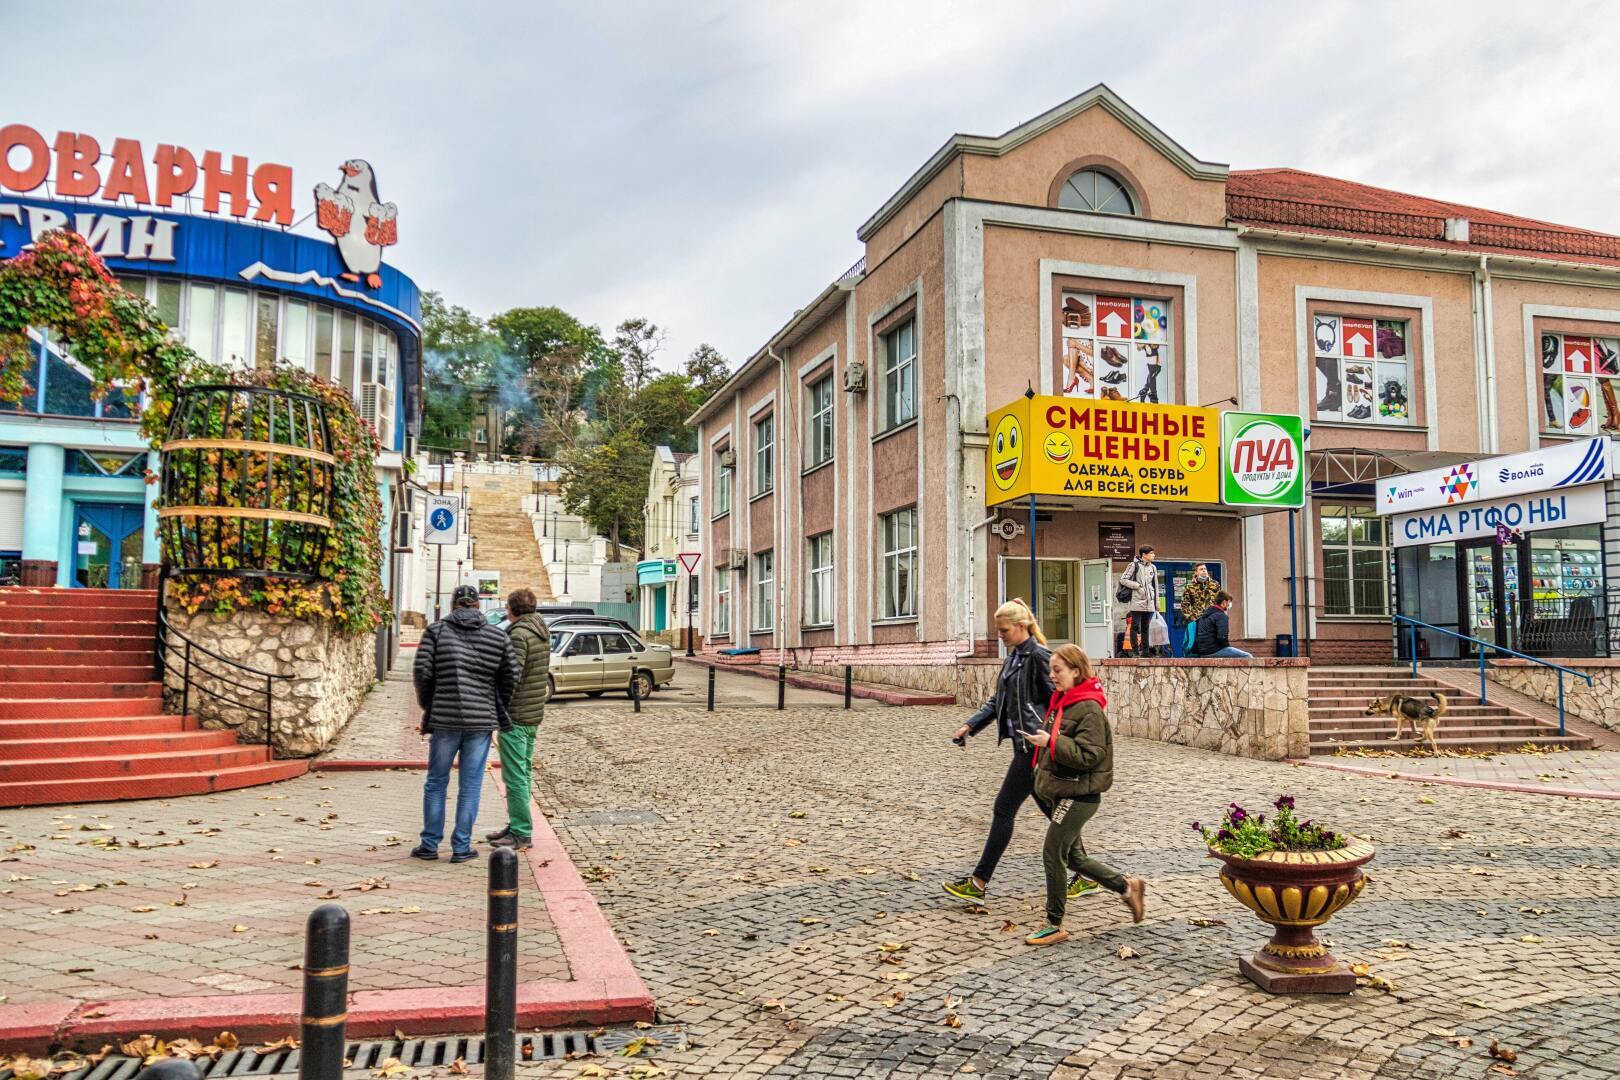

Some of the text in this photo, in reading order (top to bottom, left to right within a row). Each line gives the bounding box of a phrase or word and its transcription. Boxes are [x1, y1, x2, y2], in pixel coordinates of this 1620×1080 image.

[0, 123, 295, 226] ОВАРНЯ
[1046, 405, 1205, 438] СМЕШНЫЕ
[1083, 434, 1169, 462] ЦЕНЫ
[1233, 438, 1294, 474] ПУД
[1068, 462, 1185, 481] ОДЕЖДА, ОБУВЬ
[1241, 472, 1271, 482] ПРОДУКТЫ
[1275, 471, 1292, 480] ДОМА
[1063, 478, 1188, 497] ДЛЯ ВСЕЙ СЕМЬИ
[1397, 488, 1413, 499] win
[432, 498, 451, 506] ЗОНА
